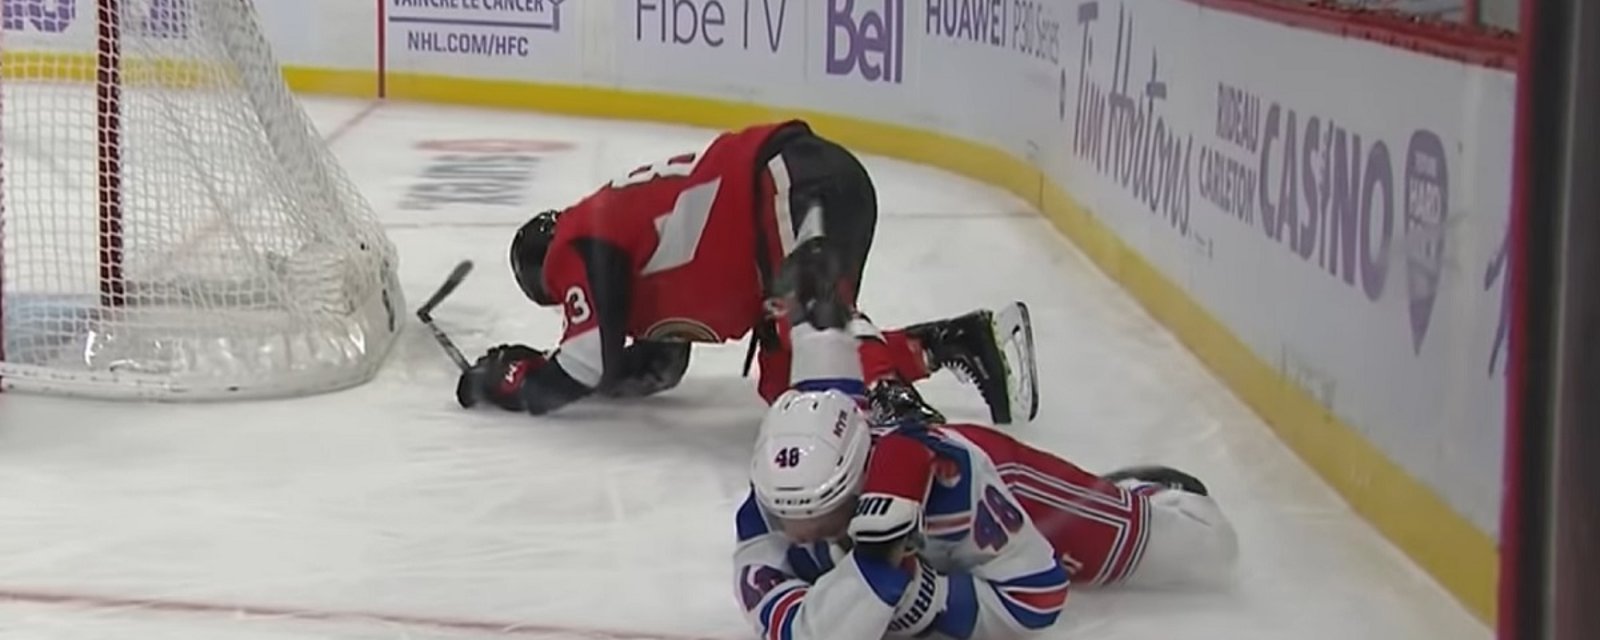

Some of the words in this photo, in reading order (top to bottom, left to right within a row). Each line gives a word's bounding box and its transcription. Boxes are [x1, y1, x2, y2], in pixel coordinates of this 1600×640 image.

[407, 30, 529, 57] NHL.COM/HFC
[826, 0, 904, 84] Bell
[926, 0, 1007, 48] HUAWEI
[1073, 2, 1105, 174] Tim
[1104, 1, 1193, 237] Hortons
[1214, 80, 1260, 154] RIDEAU
[1199, 144, 1257, 226] CARLETON
[1259, 101, 1394, 303] CASINO
[563, 285, 591, 330] 3
[774, 446, 800, 468] 48
[974, 484, 1024, 552] 48
